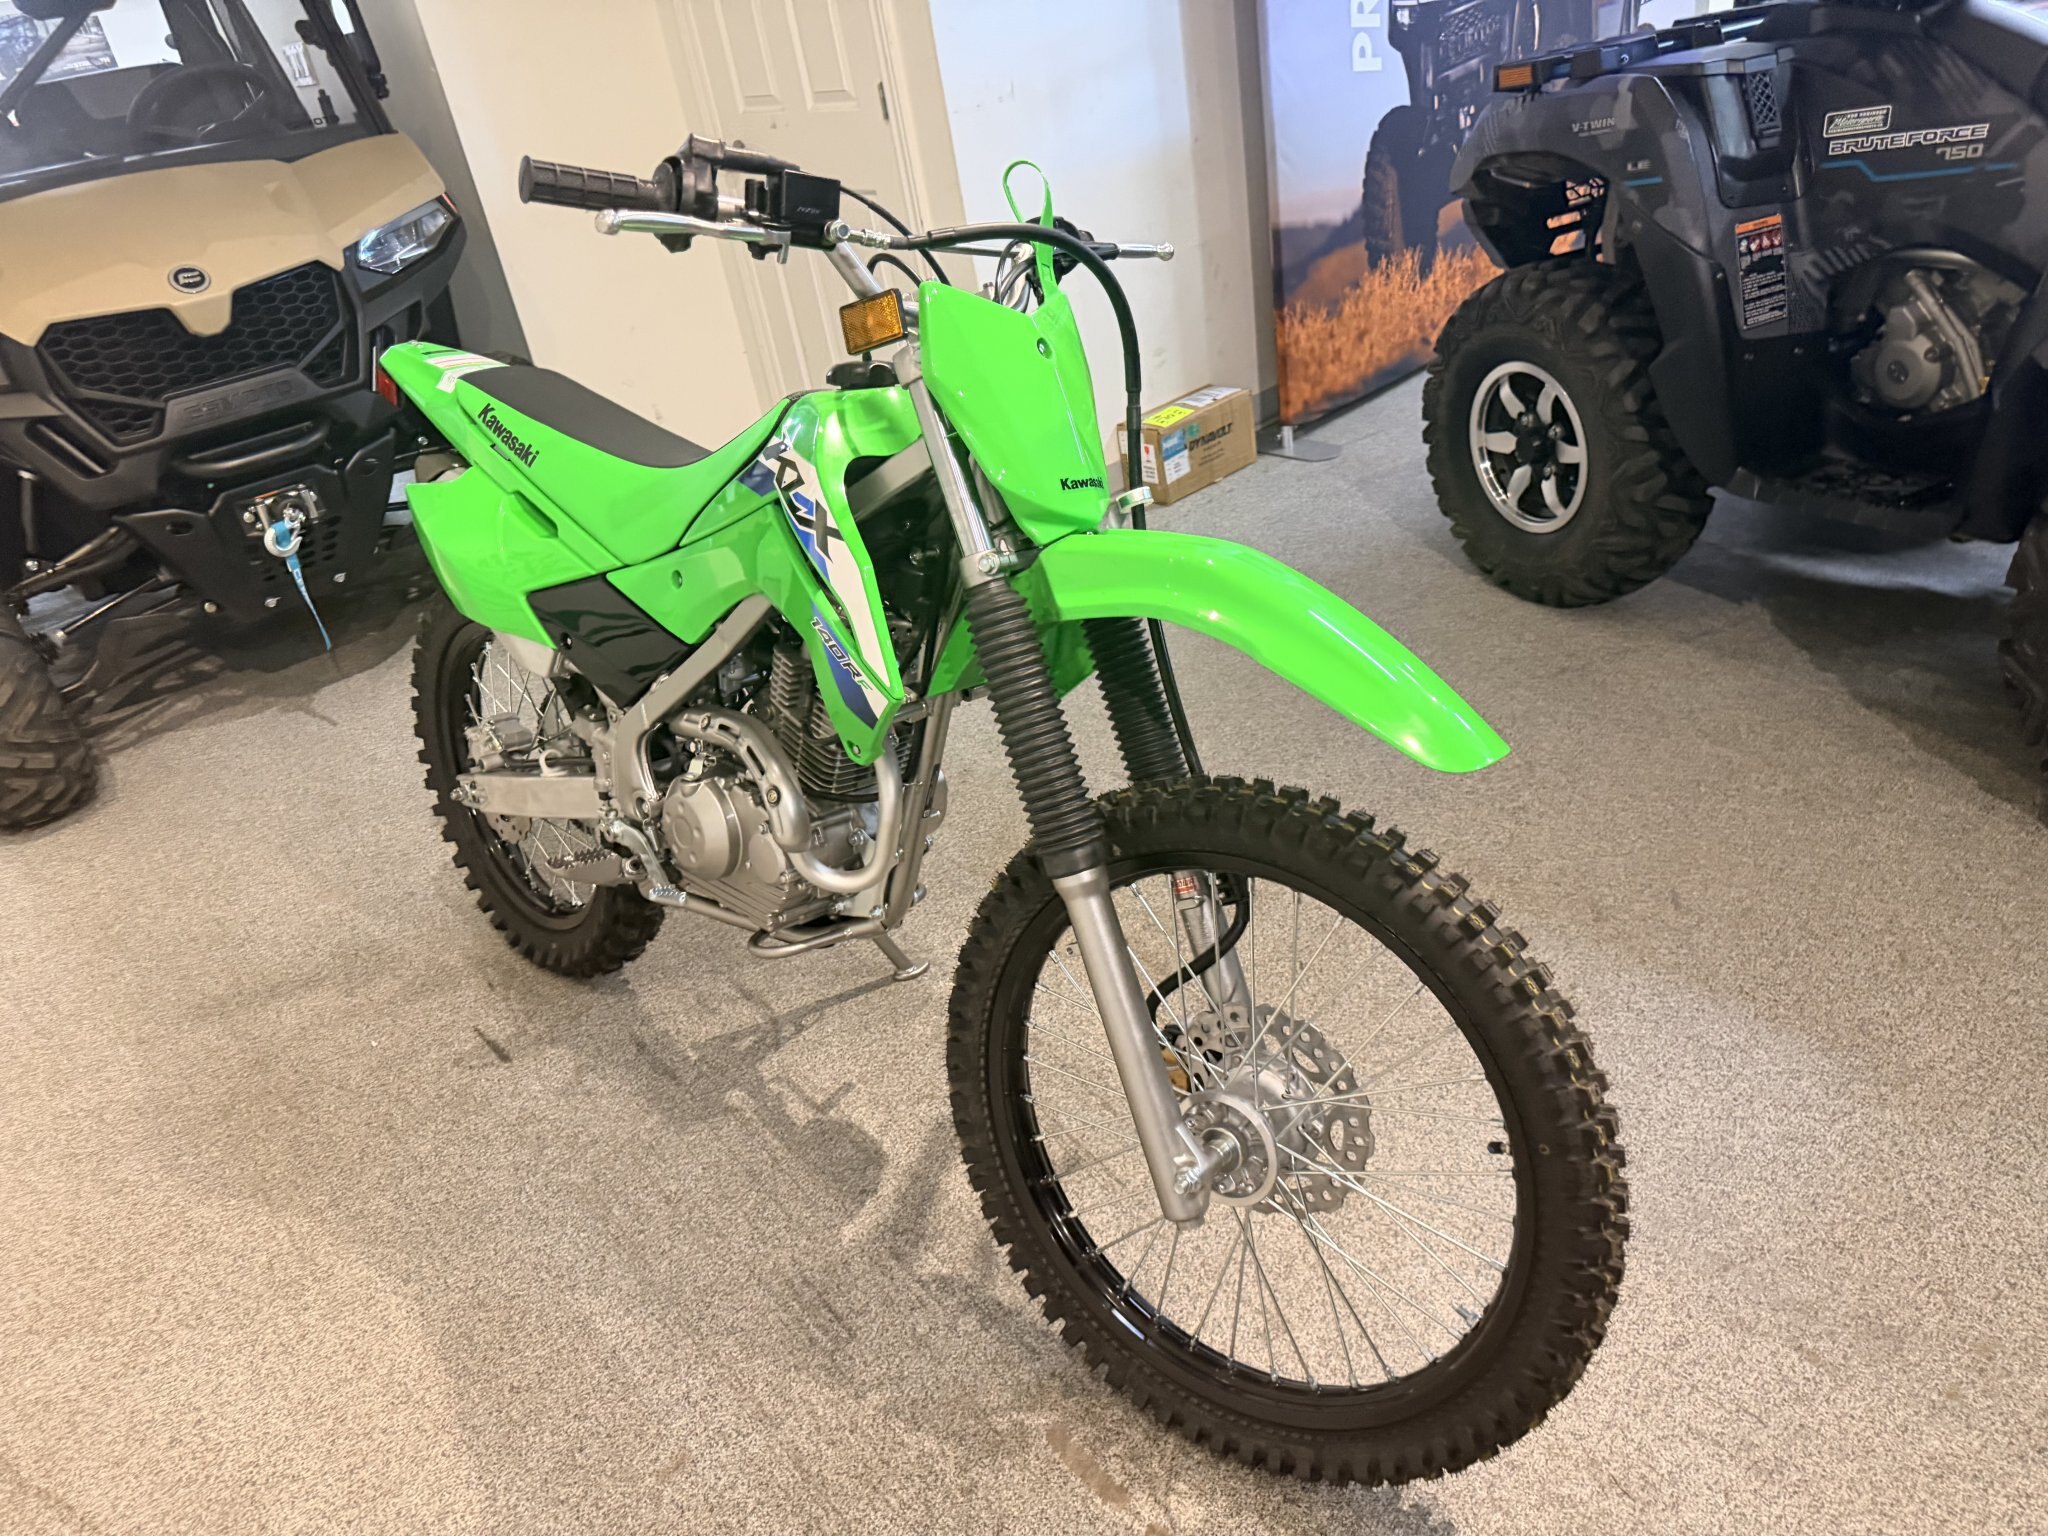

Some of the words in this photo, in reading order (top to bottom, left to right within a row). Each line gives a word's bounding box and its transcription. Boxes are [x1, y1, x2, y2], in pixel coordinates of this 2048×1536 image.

[1571, 117, 1616, 133] V-TWIN
[1935, 142, 1985, 161] 750
[477, 402, 540, 468] Kawasaki
